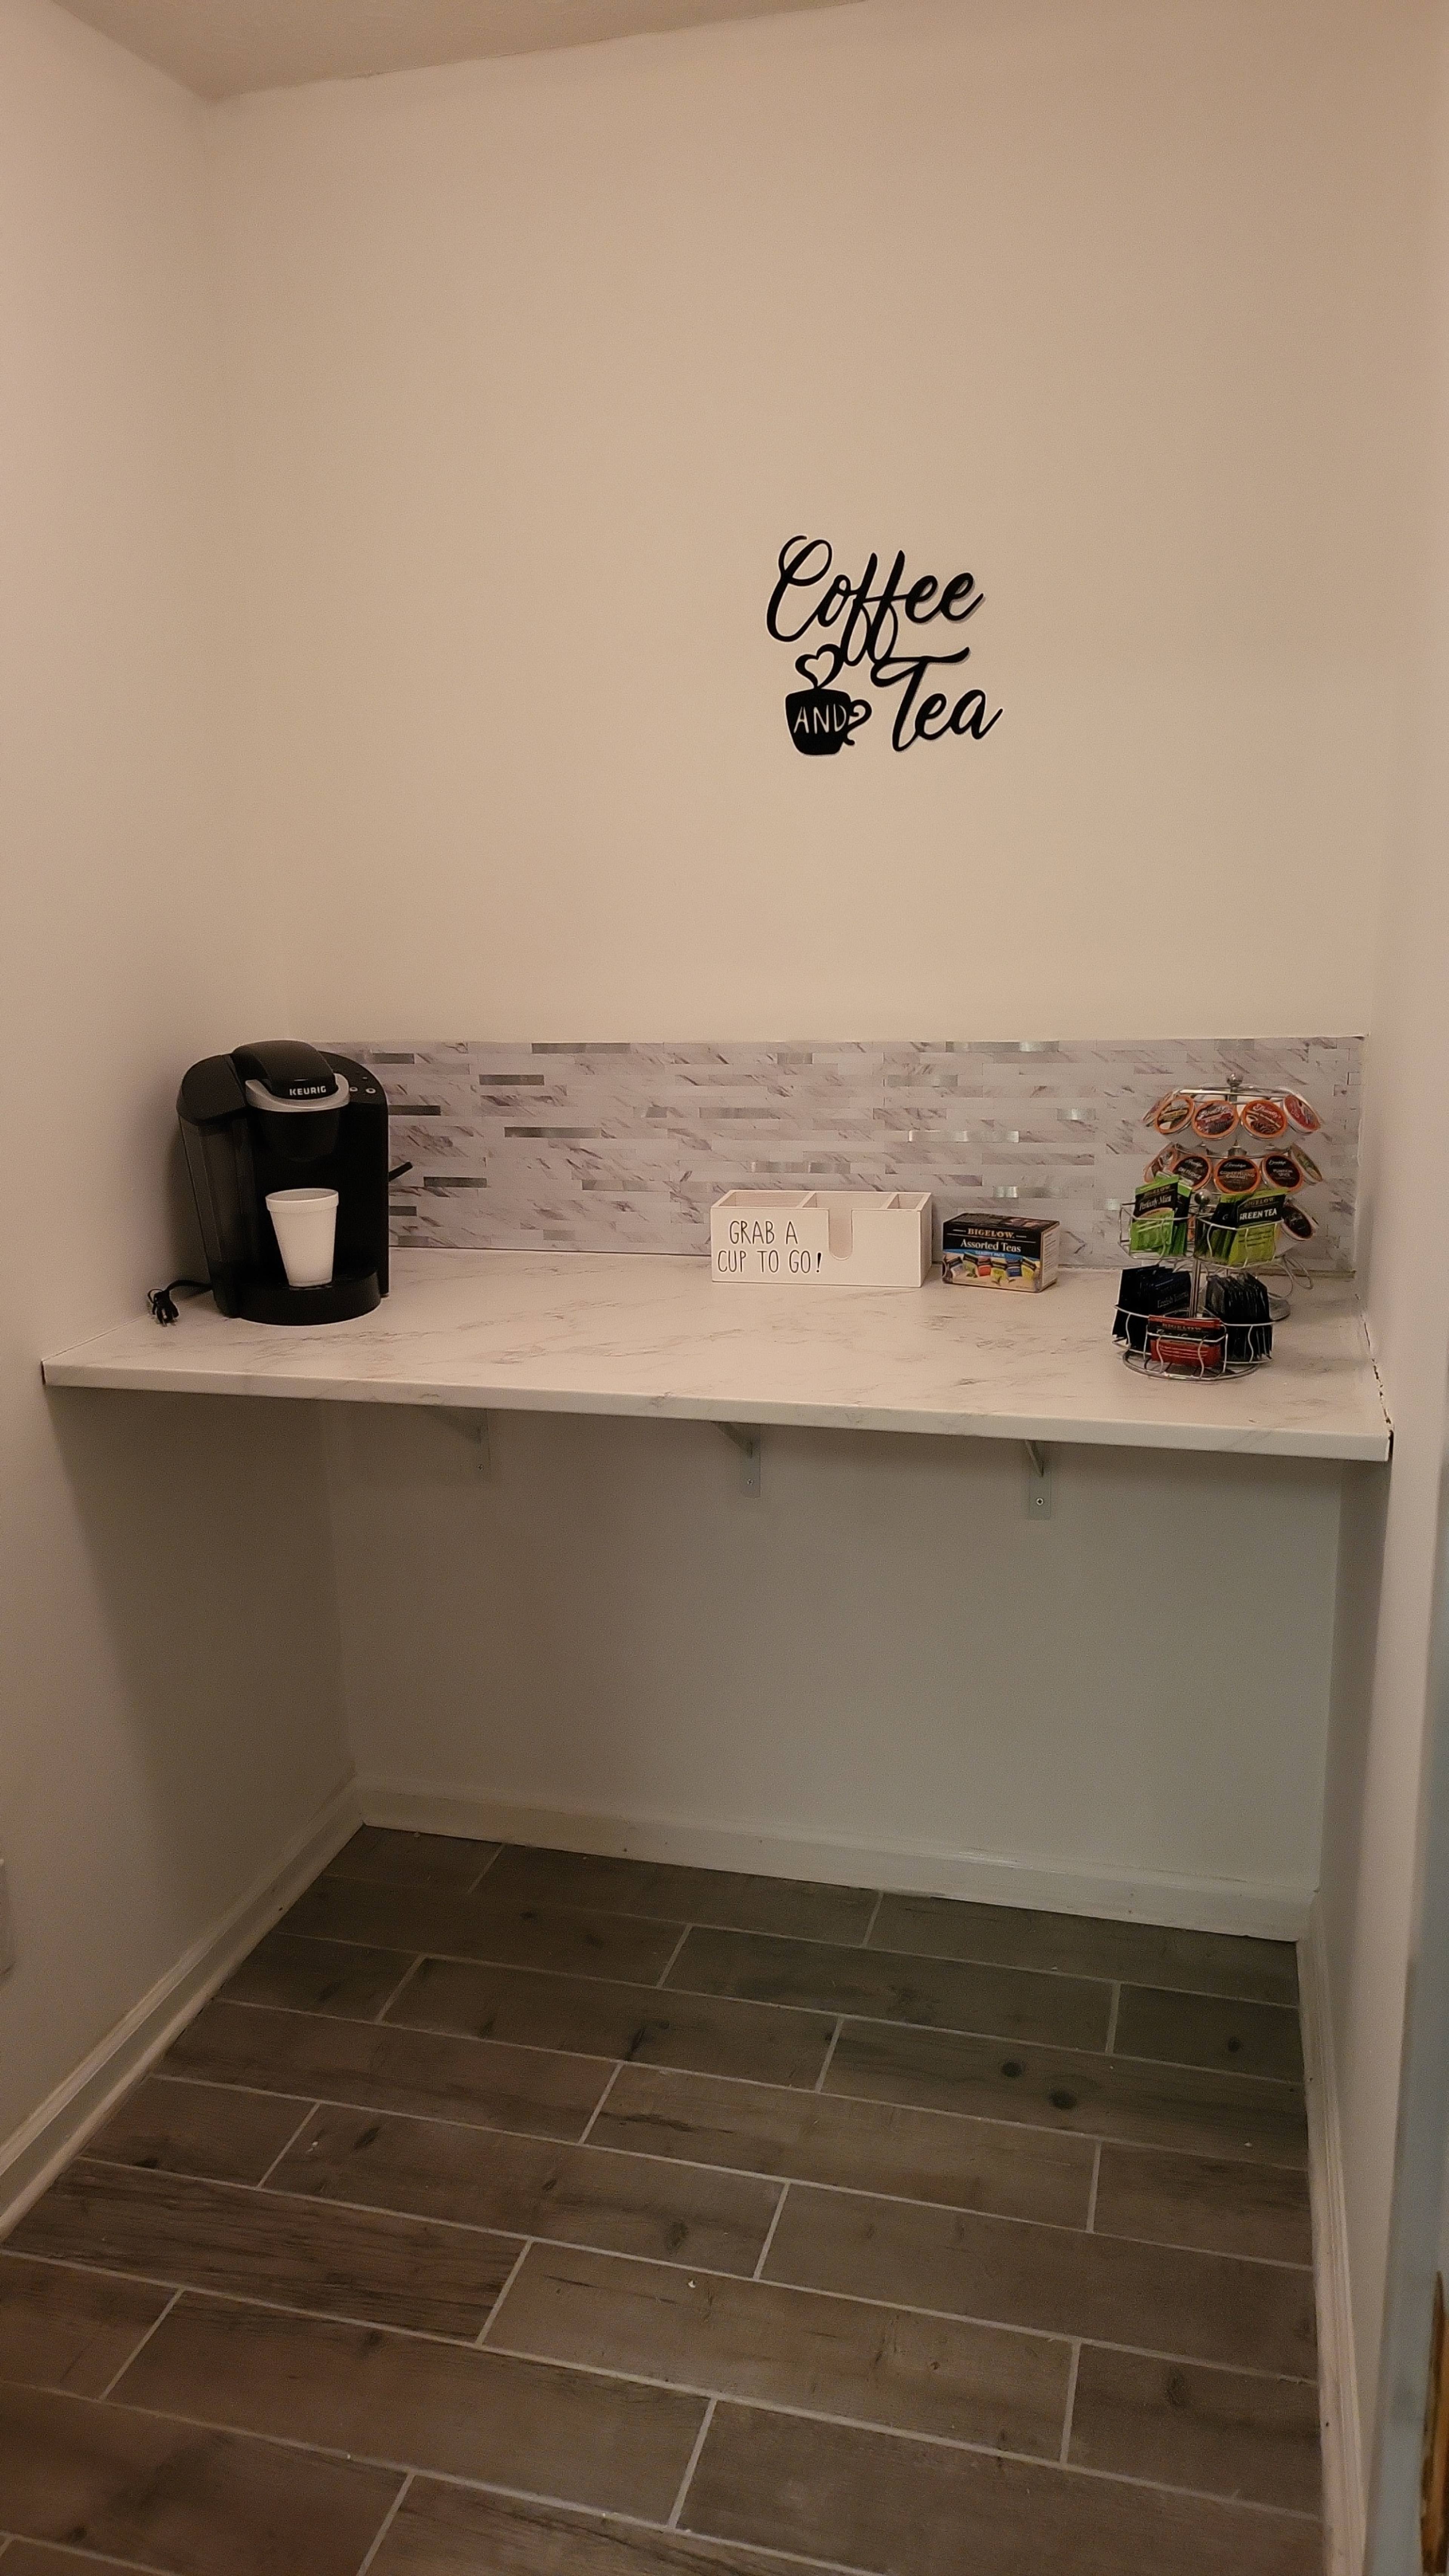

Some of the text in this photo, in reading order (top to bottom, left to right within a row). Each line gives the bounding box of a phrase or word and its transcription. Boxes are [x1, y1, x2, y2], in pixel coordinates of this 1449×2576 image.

[766, 535, 984, 666] Coffee
[871, 647, 1003, 752] Tea
[794, 704, 847, 734] AND
[289, 1086, 326, 1096] KEURIG
[1240, 1210, 1263, 1221] GREEN
[1264, 1208, 1277, 1217] TEA
[729, 1220, 798, 1244] GRAB A
[960, 1238, 1021, 1253] Assorted Teas
[718, 1250, 822, 1273] CUP TO GO!
